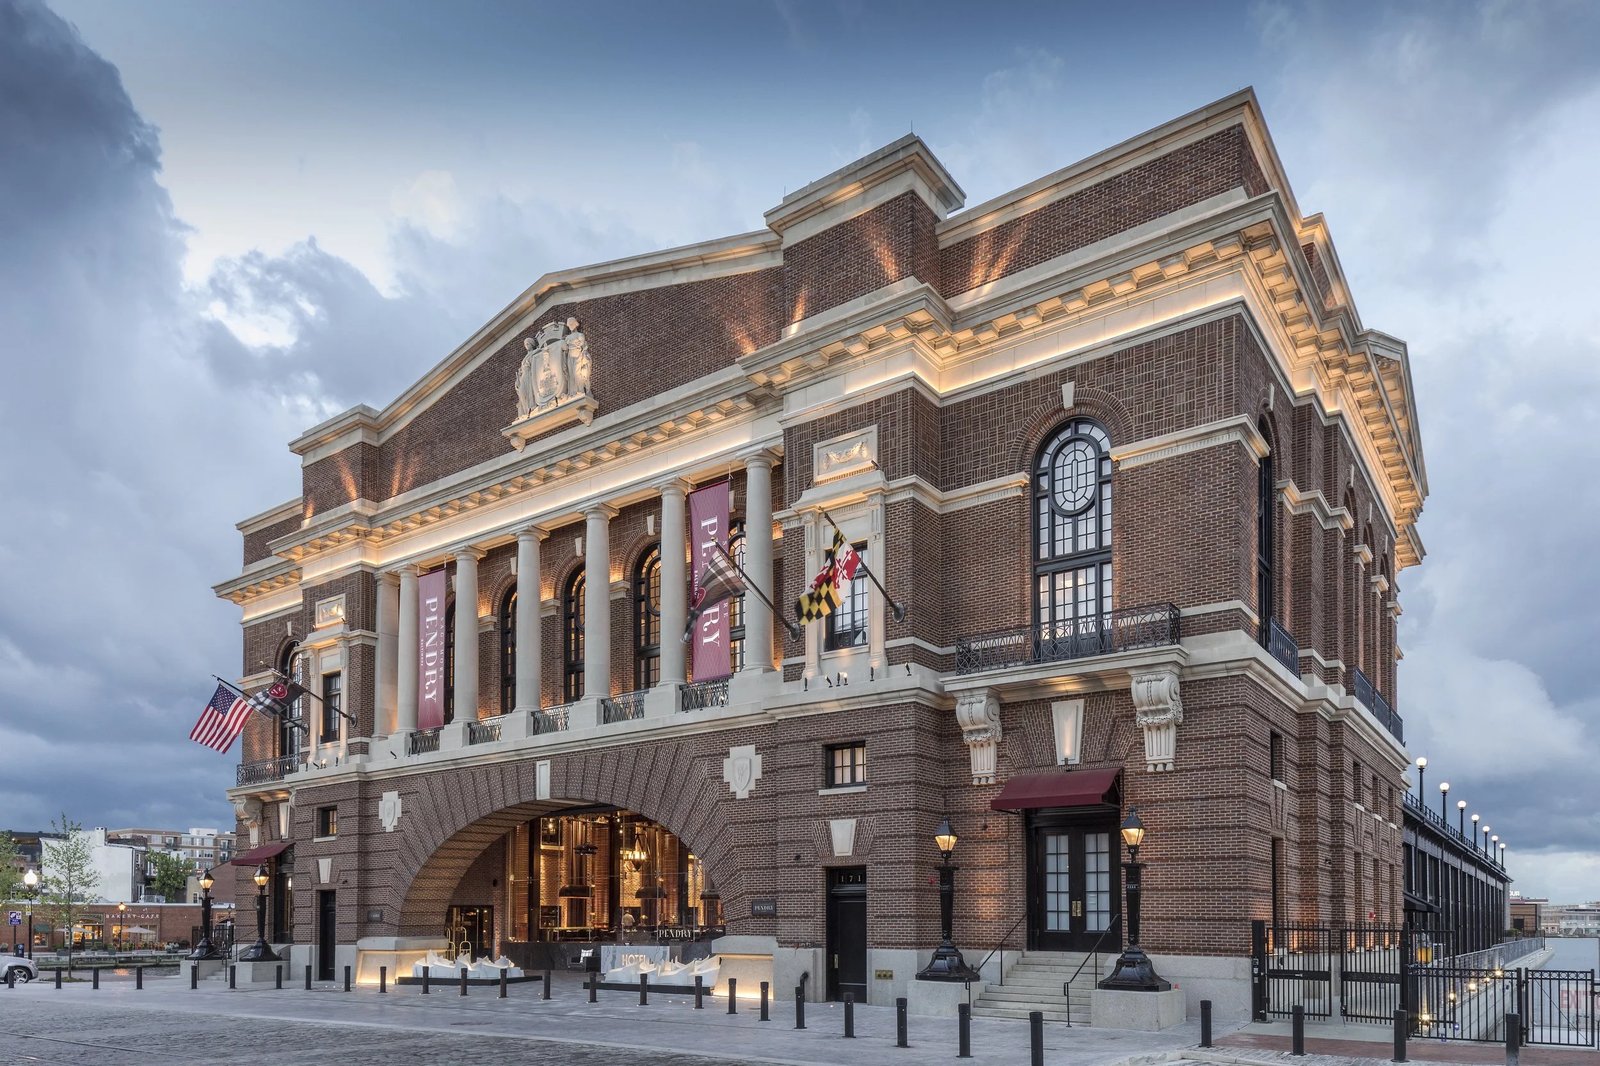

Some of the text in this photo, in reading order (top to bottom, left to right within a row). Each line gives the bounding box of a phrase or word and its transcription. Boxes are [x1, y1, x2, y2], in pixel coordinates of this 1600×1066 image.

[701, 515, 720, 647] PERY
[425, 596, 438, 703] PENDRY
[841, 874, 861, 882] 171
[659, 929, 692, 938] PENDRY
